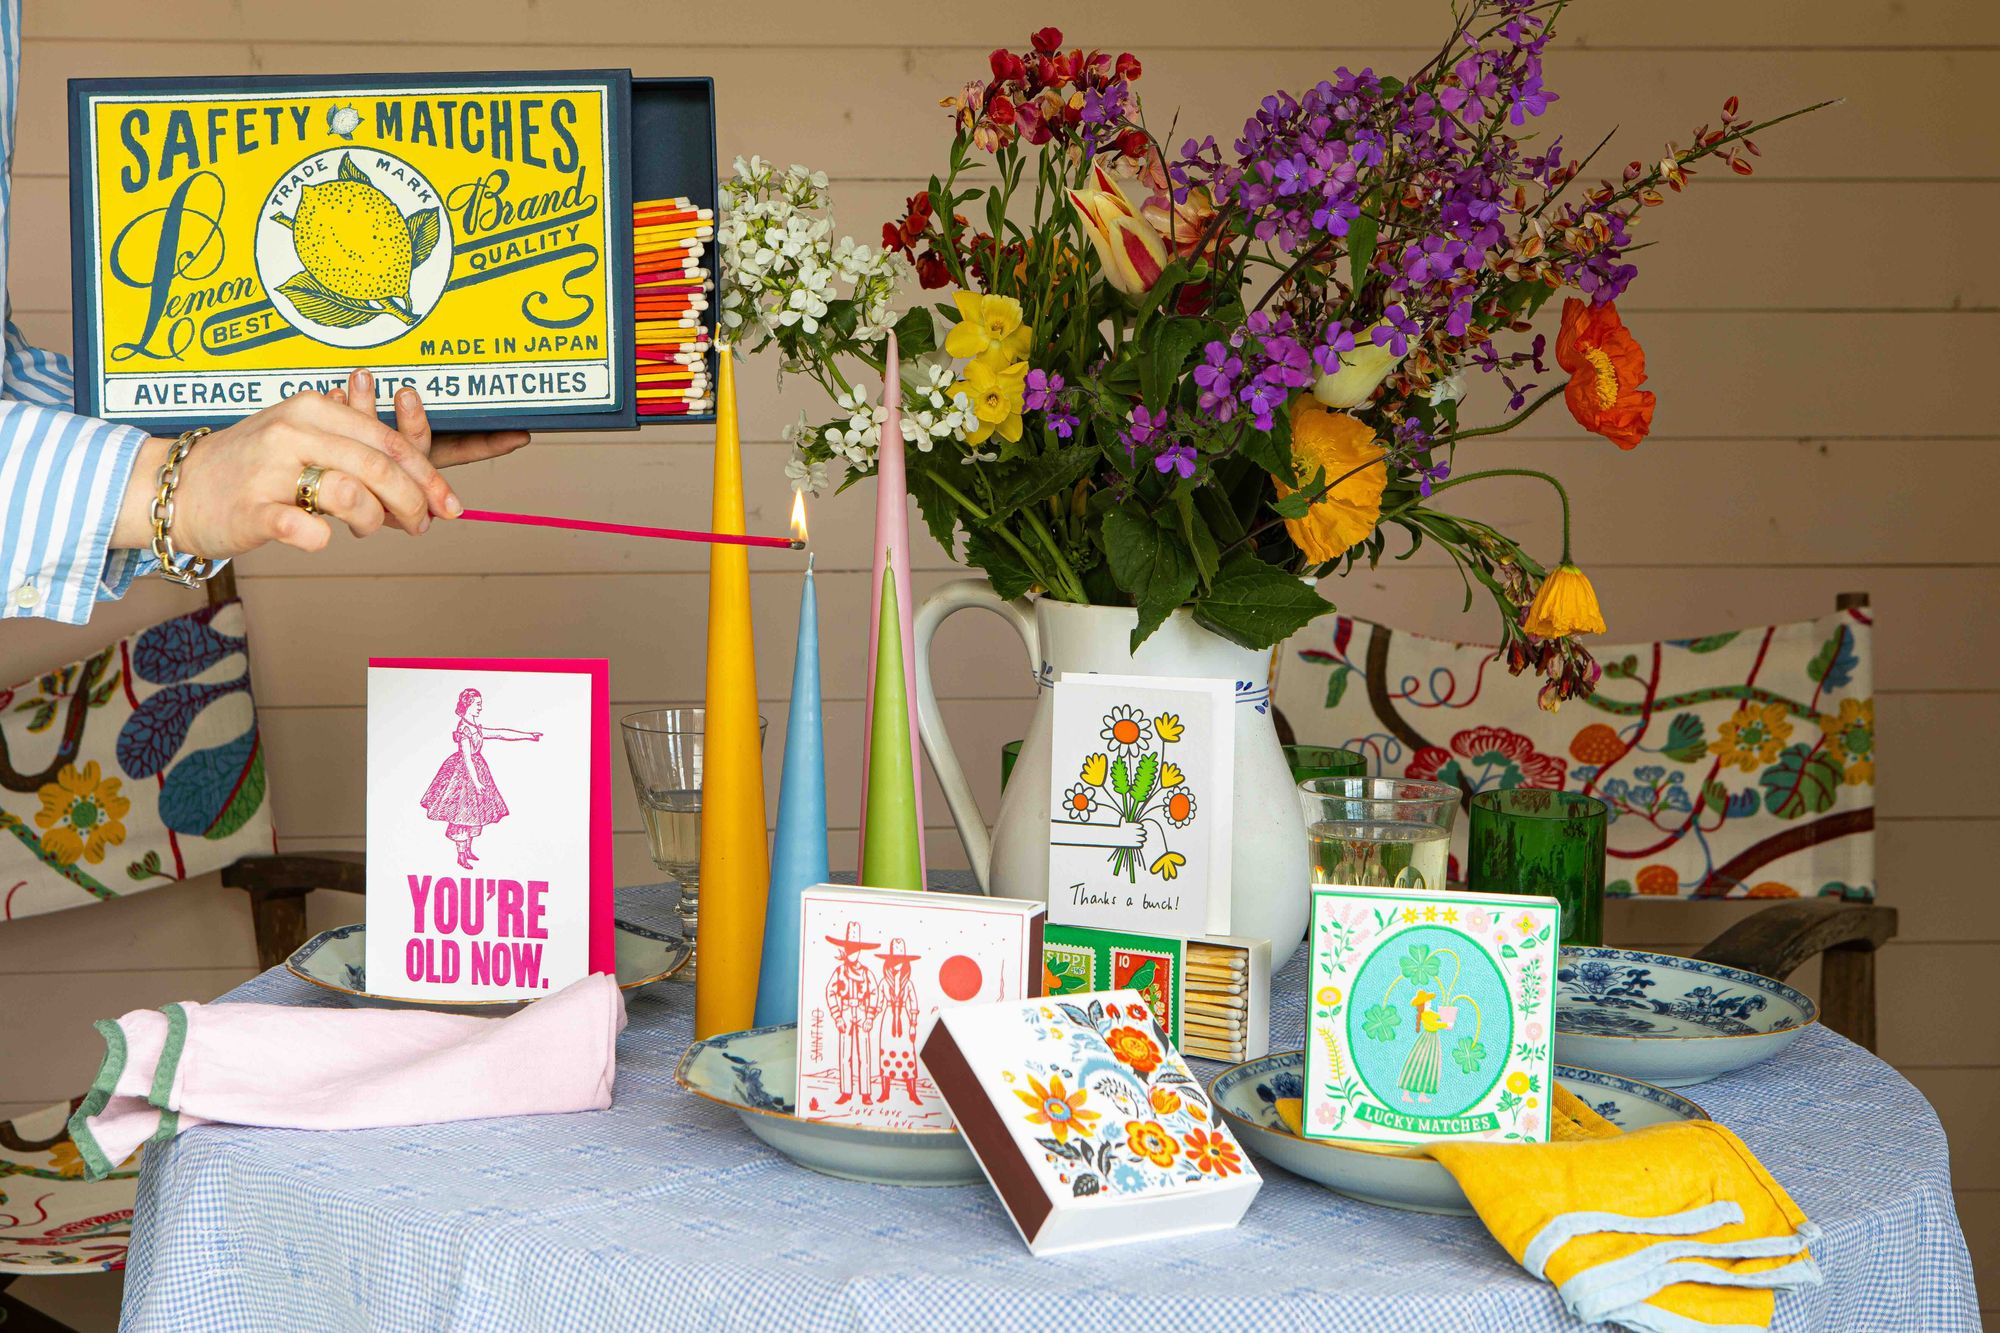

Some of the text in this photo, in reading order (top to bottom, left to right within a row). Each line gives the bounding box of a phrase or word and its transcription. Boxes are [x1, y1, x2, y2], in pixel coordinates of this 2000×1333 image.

[120, 99, 579, 193] SAFETY MATCHES
[271, 158, 432, 208] TRADE MARK
[110, 166, 598, 361] Lemon Brand
[213, 224, 580, 344] BEST QUALITY
[420, 335, 598, 355] MADE IN JAPAN
[134, 381, 262, 406] AVERAGE
[426, 375, 459, 398] 45
[468, 372, 587, 396] MATCHES
[407, 874, 549, 940] YOU'RE
[1070, 882, 1180, 910] Thanks a bunch!
[406, 938, 549, 989] OLD NOW.
[1118, 955, 1130, 968] 10
[849, 1106, 902, 1117] LOVE LOVE
[1364, 1107, 1491, 1132] LUCKY MATCHES
